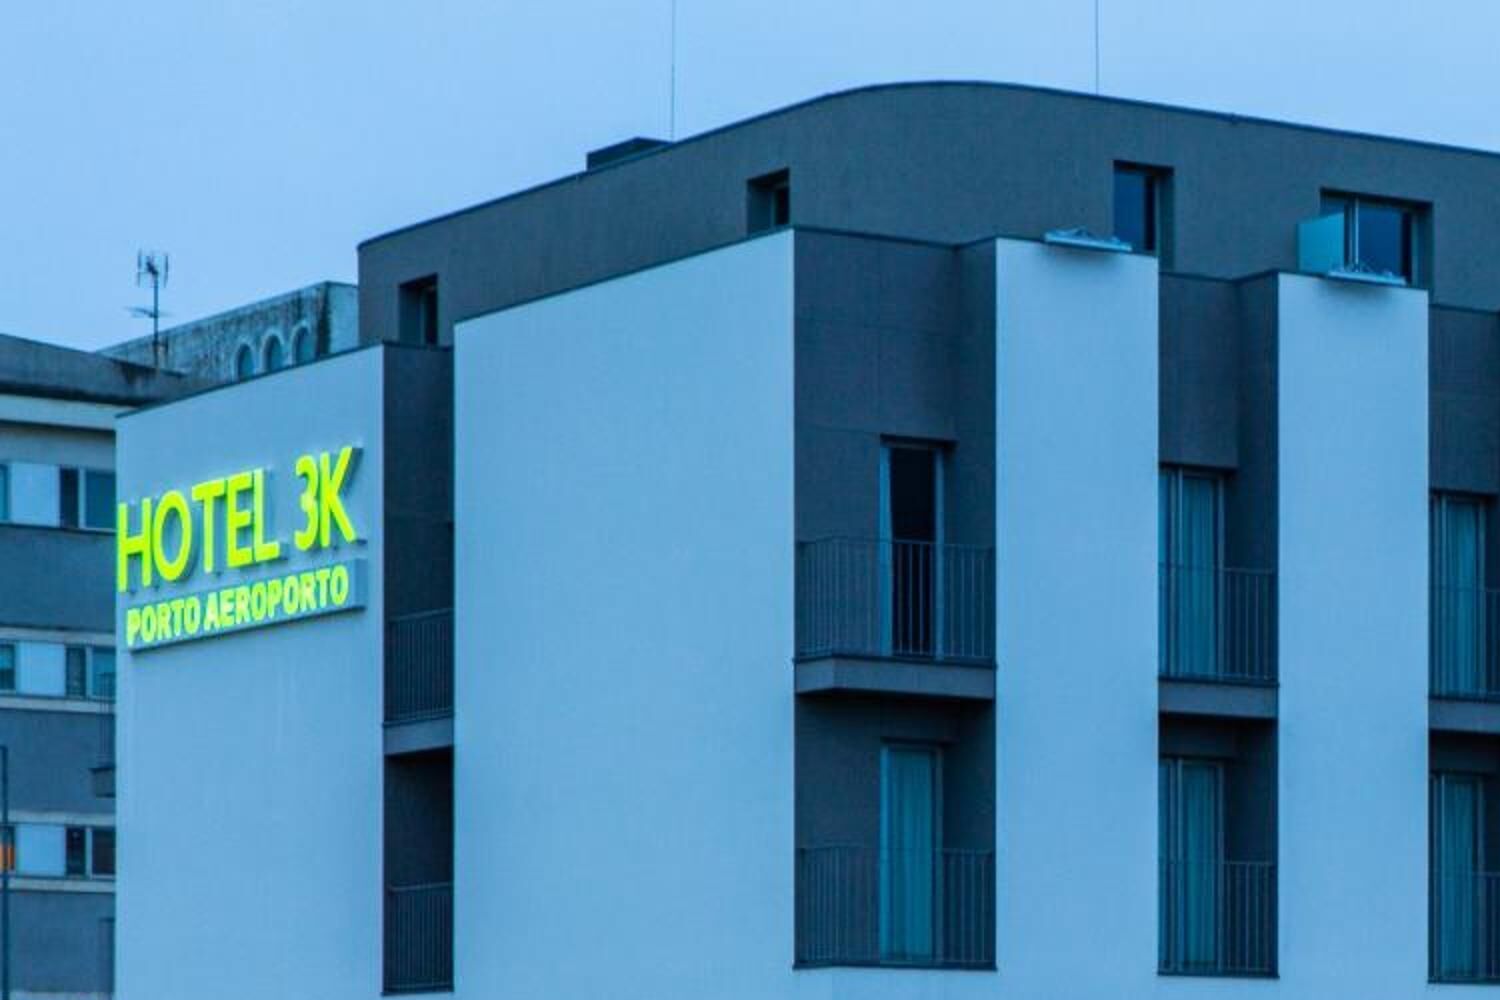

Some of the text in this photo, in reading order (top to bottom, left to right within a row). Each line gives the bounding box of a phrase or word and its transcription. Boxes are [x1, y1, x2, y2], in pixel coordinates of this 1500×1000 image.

[117, 446, 358, 593] HOTEL 3K
[127, 565, 349, 646] PORTO AEROPORTO
